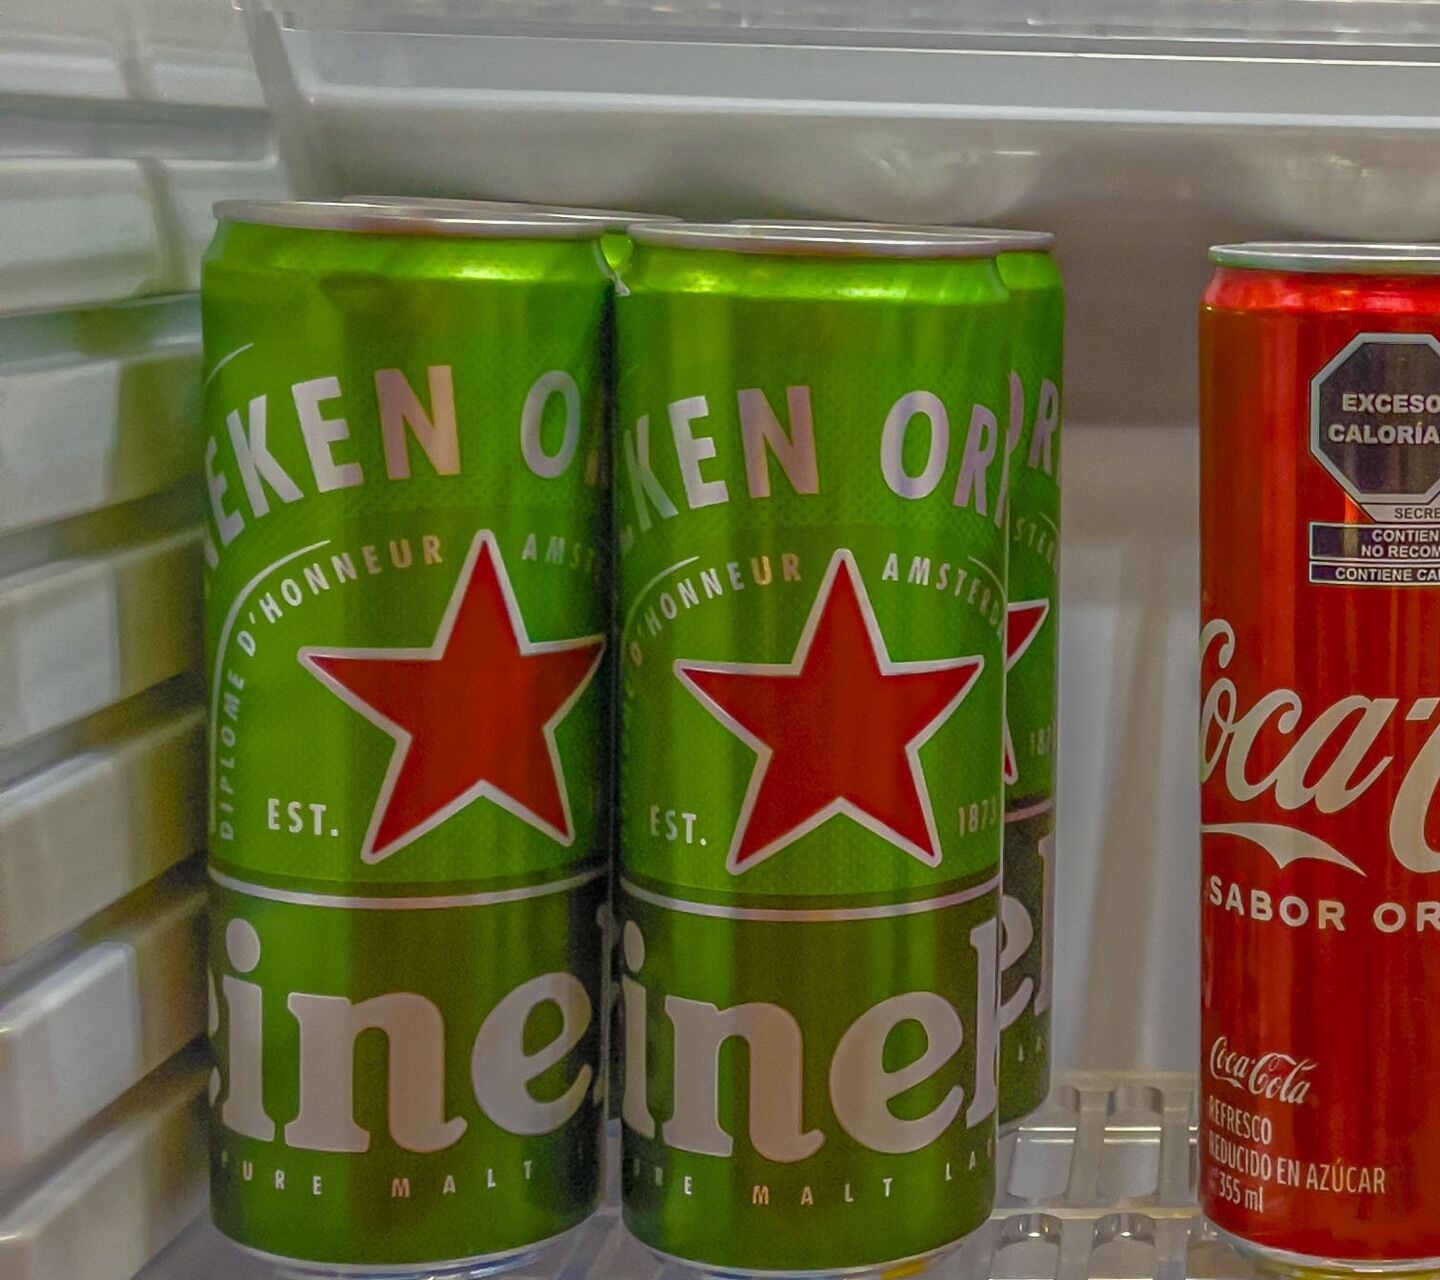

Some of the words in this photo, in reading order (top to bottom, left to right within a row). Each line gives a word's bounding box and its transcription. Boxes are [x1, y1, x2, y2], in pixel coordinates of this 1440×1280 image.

[202, 365, 461, 572] EKEN
[620, 385, 820, 552] KEN
[879, 390, 1004, 526] OR
[1335, 567, 1412, 582] CONTIENE
[1361, 545, 1384, 557] NO
[881, 552, 1002, 642] AMSTERD
[218, 669, 245, 841] DIPLOME
[236, 535, 443, 657] D'HONNEUR
[267, 798, 339, 838] EST.
[650, 805, 708, 848] EST.
[1210, 875, 1346, 932] SABOR
[1209, 1035, 1319, 1105] Coca-Cola
[1208, 1094, 1273, 1146] REFRESCO
[219, 1142, 323, 1196] URE
[390, 1158, 534, 1199] MALT
[1208, 1129, 1272, 1182] REDUCIDO
[1276, 1155, 1301, 1189] EN
[1305, 1156, 1387, 1195] AZÚCAR
[751, 1175, 894, 1207] MALT
[1218, 1170, 1242, 1206] 355
[1244, 1185, 1265, 1214] ml
